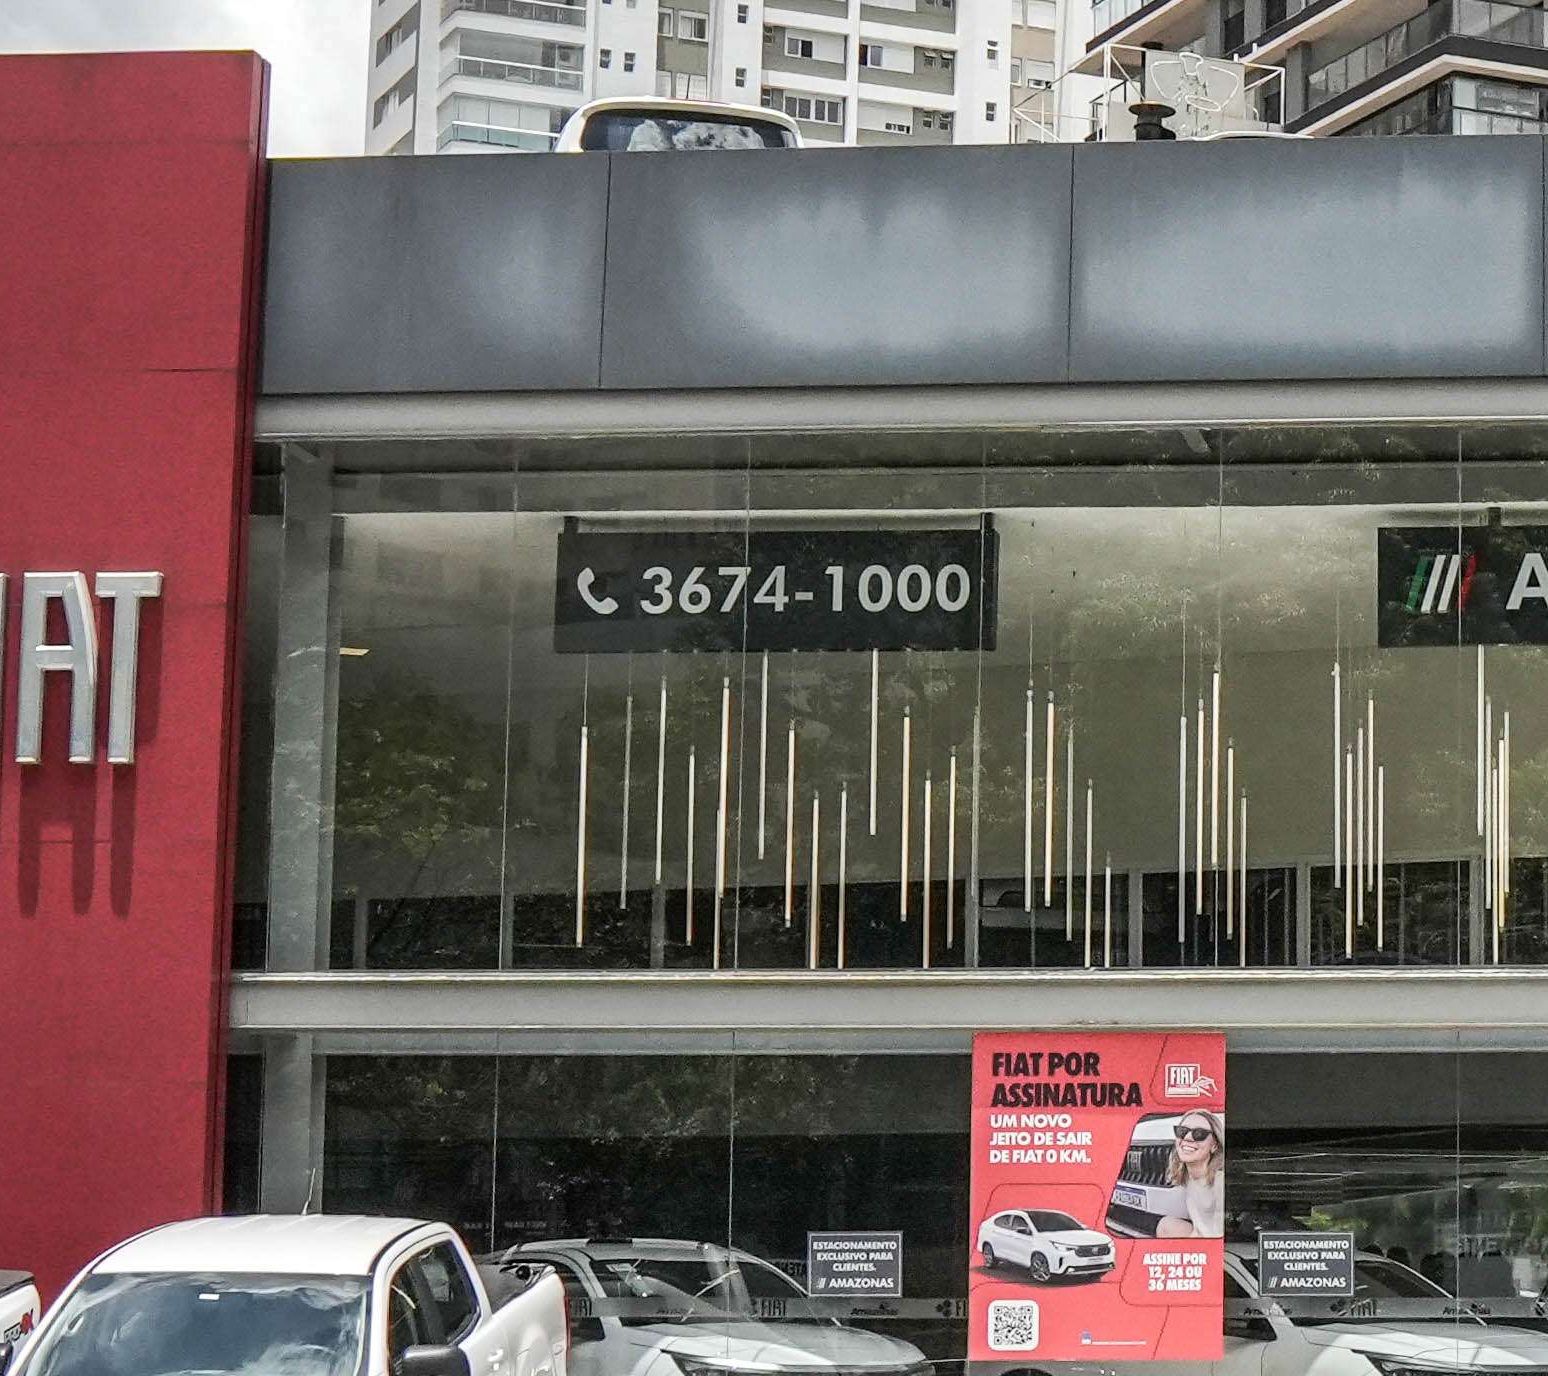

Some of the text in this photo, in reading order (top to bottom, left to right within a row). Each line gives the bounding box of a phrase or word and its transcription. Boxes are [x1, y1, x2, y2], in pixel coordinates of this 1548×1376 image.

[639, 564, 971, 614] 3674-1000
[992, 1052, 1100, 1076] FIAT POR
[1170, 1067, 1196, 1085] FIAT
[991, 1083, 1143, 1107] ASSINATURA
[990, 1114, 1072, 1128] UM NOVO
[990, 1132, 1092, 1145] JEITO DE SAIR
[990, 1149, 1091, 1163] DE FIAT 0 KM.
[813, 1241, 897, 1250] ESTACIONAMENTO
[1264, 1240, 1349, 1249] ESTACIONAMENTO
[817, 1252, 893, 1260] EXCLUSIVO PARA
[1143, 1253, 1207, 1265] ASSINE POR
[1268, 1251, 1345, 1260] EXCLUSIVO PARA
[833, 1262, 876, 1271] CLIENTES.
[1284, 1262, 1329, 1271] CLIENTES.
[1148, 1267, 1203, 1280] 12, 24 OU
[829, 1278, 894, 1288] AMAZONAS
[1148, 1279, 1202, 1291] 36 MESES
[1280, 1277, 1347, 1287] AMAZONAS
